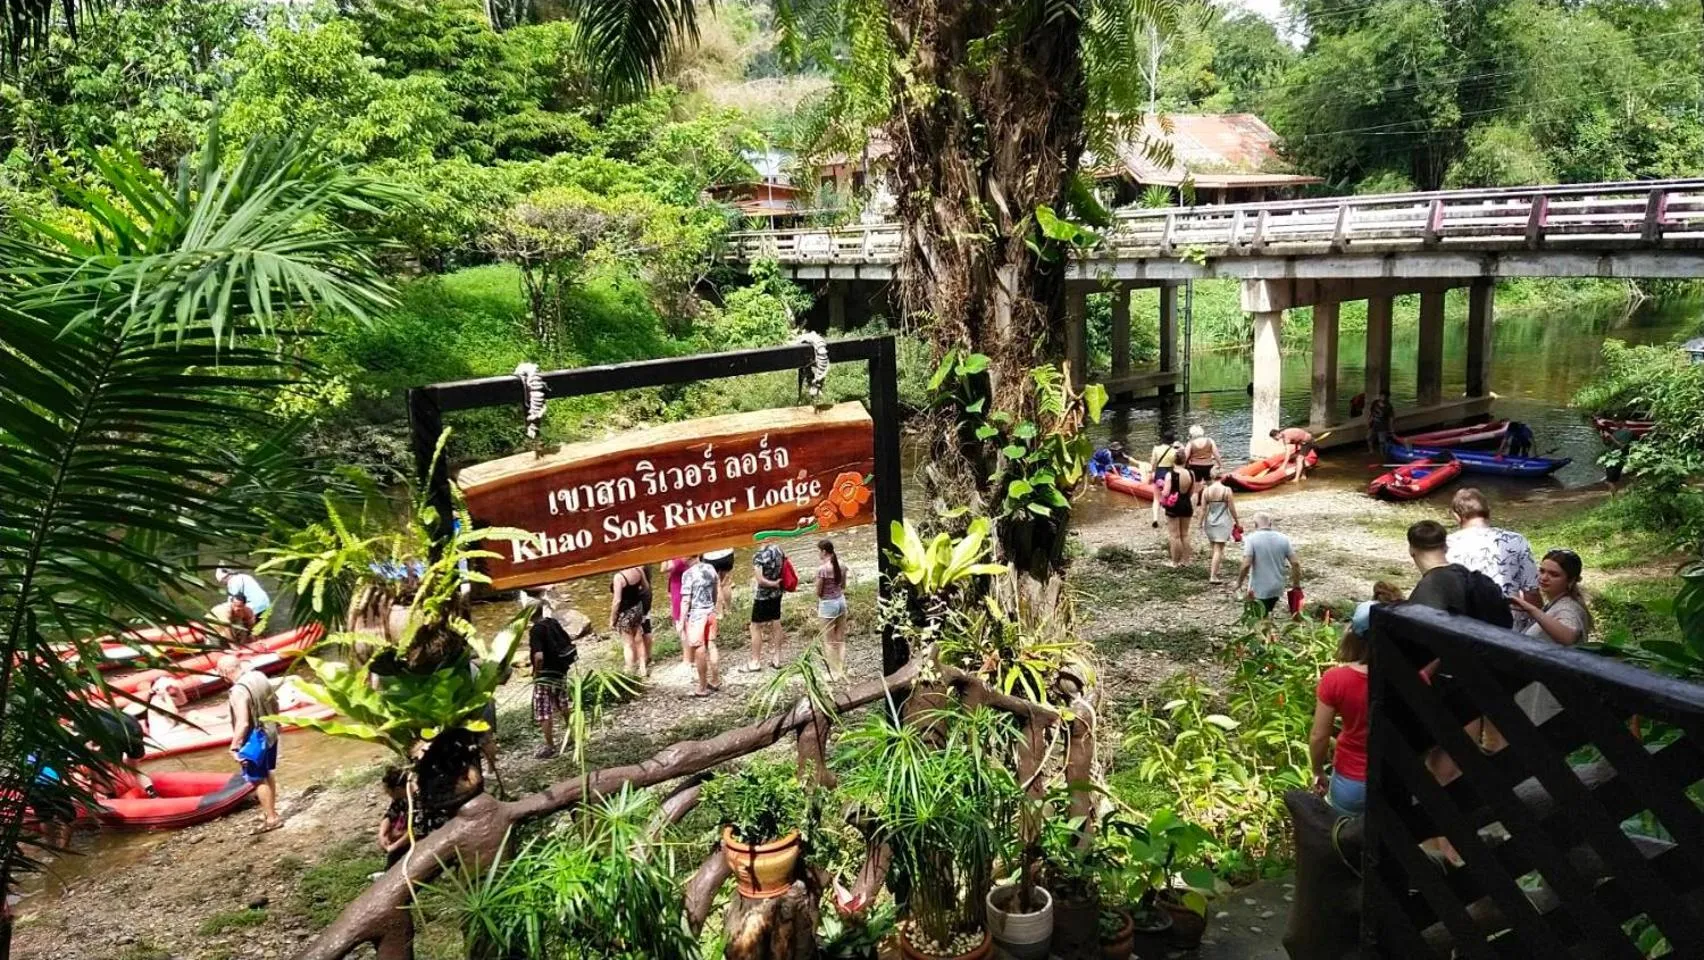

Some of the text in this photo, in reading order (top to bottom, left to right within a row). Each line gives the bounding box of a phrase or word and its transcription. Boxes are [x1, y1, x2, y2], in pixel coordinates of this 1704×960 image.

[549, 432, 789, 516] เขาสก ริเวอร์ ลอร์จ
[511, 477, 822, 564] Khao Sok River Lodge
